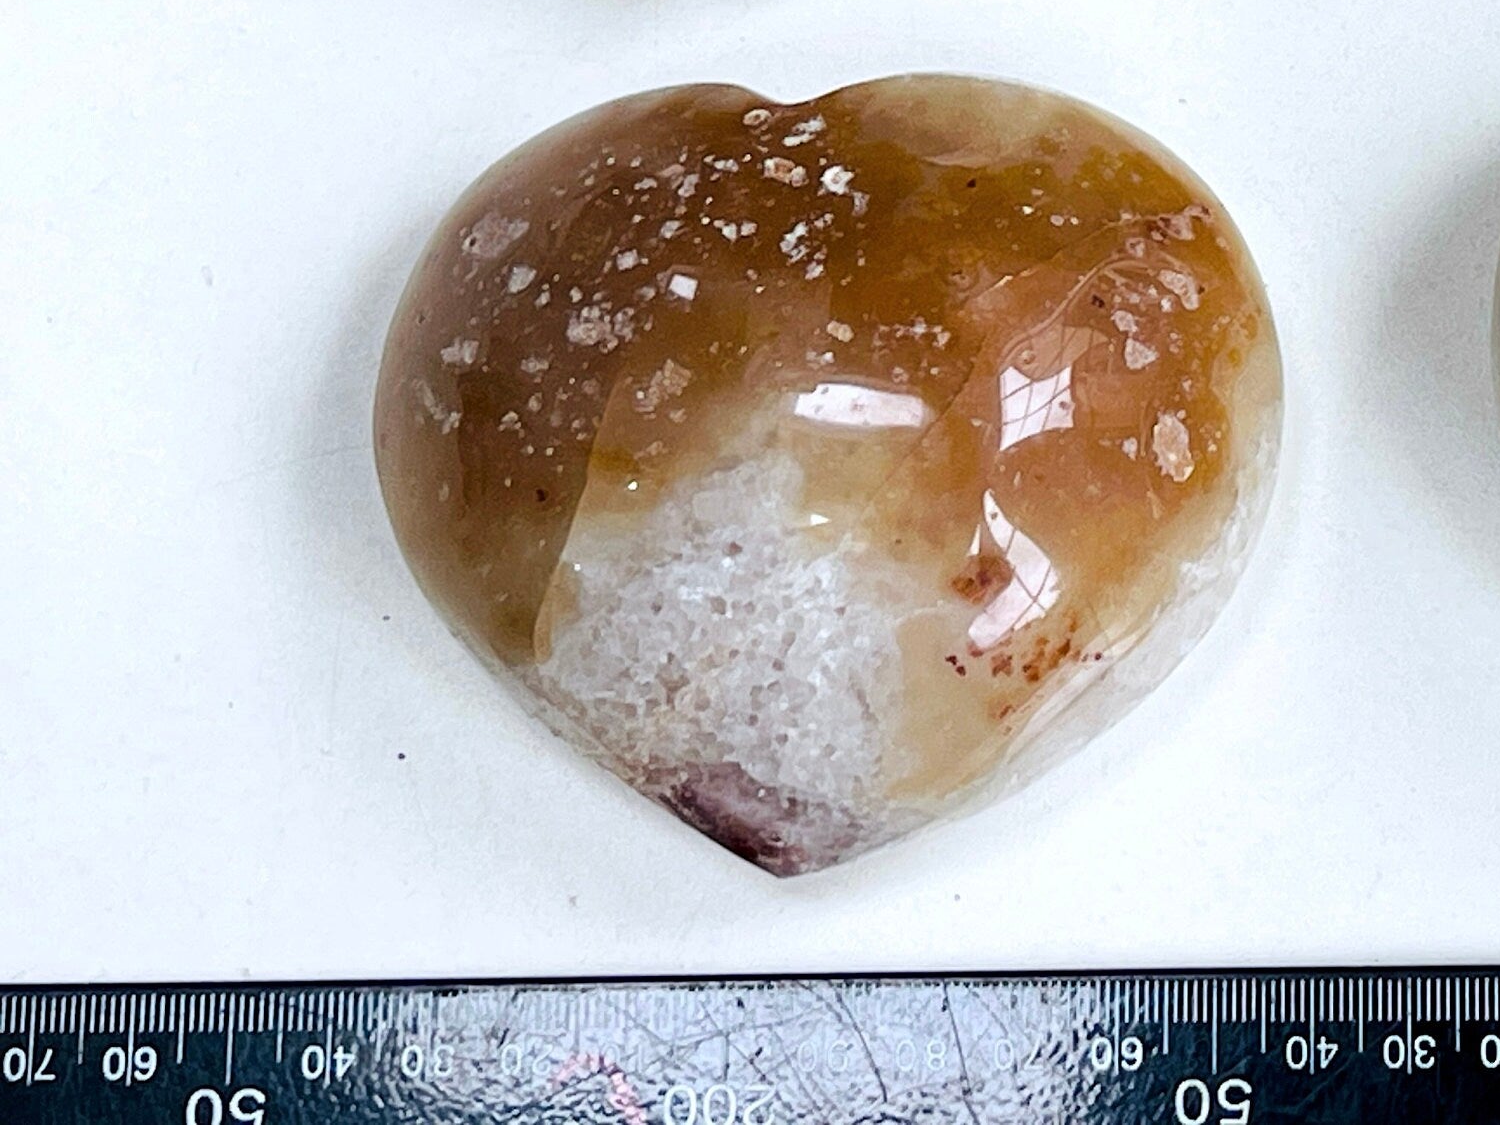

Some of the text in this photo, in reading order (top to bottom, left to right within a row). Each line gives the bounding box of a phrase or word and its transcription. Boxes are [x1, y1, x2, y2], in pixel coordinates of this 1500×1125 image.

[3, 1047, 56, 1082] 70
[102, 1046, 157, 1081] 60
[302, 1045, 355, 1079] 40
[401, 1044, 454, 1077] 30
[1090, 1036, 1144, 1070] 60
[1285, 1035, 1339, 1070] 40
[1382, 1035, 1436, 1069] 30
[1174, 1078, 1253, 1125] 50
